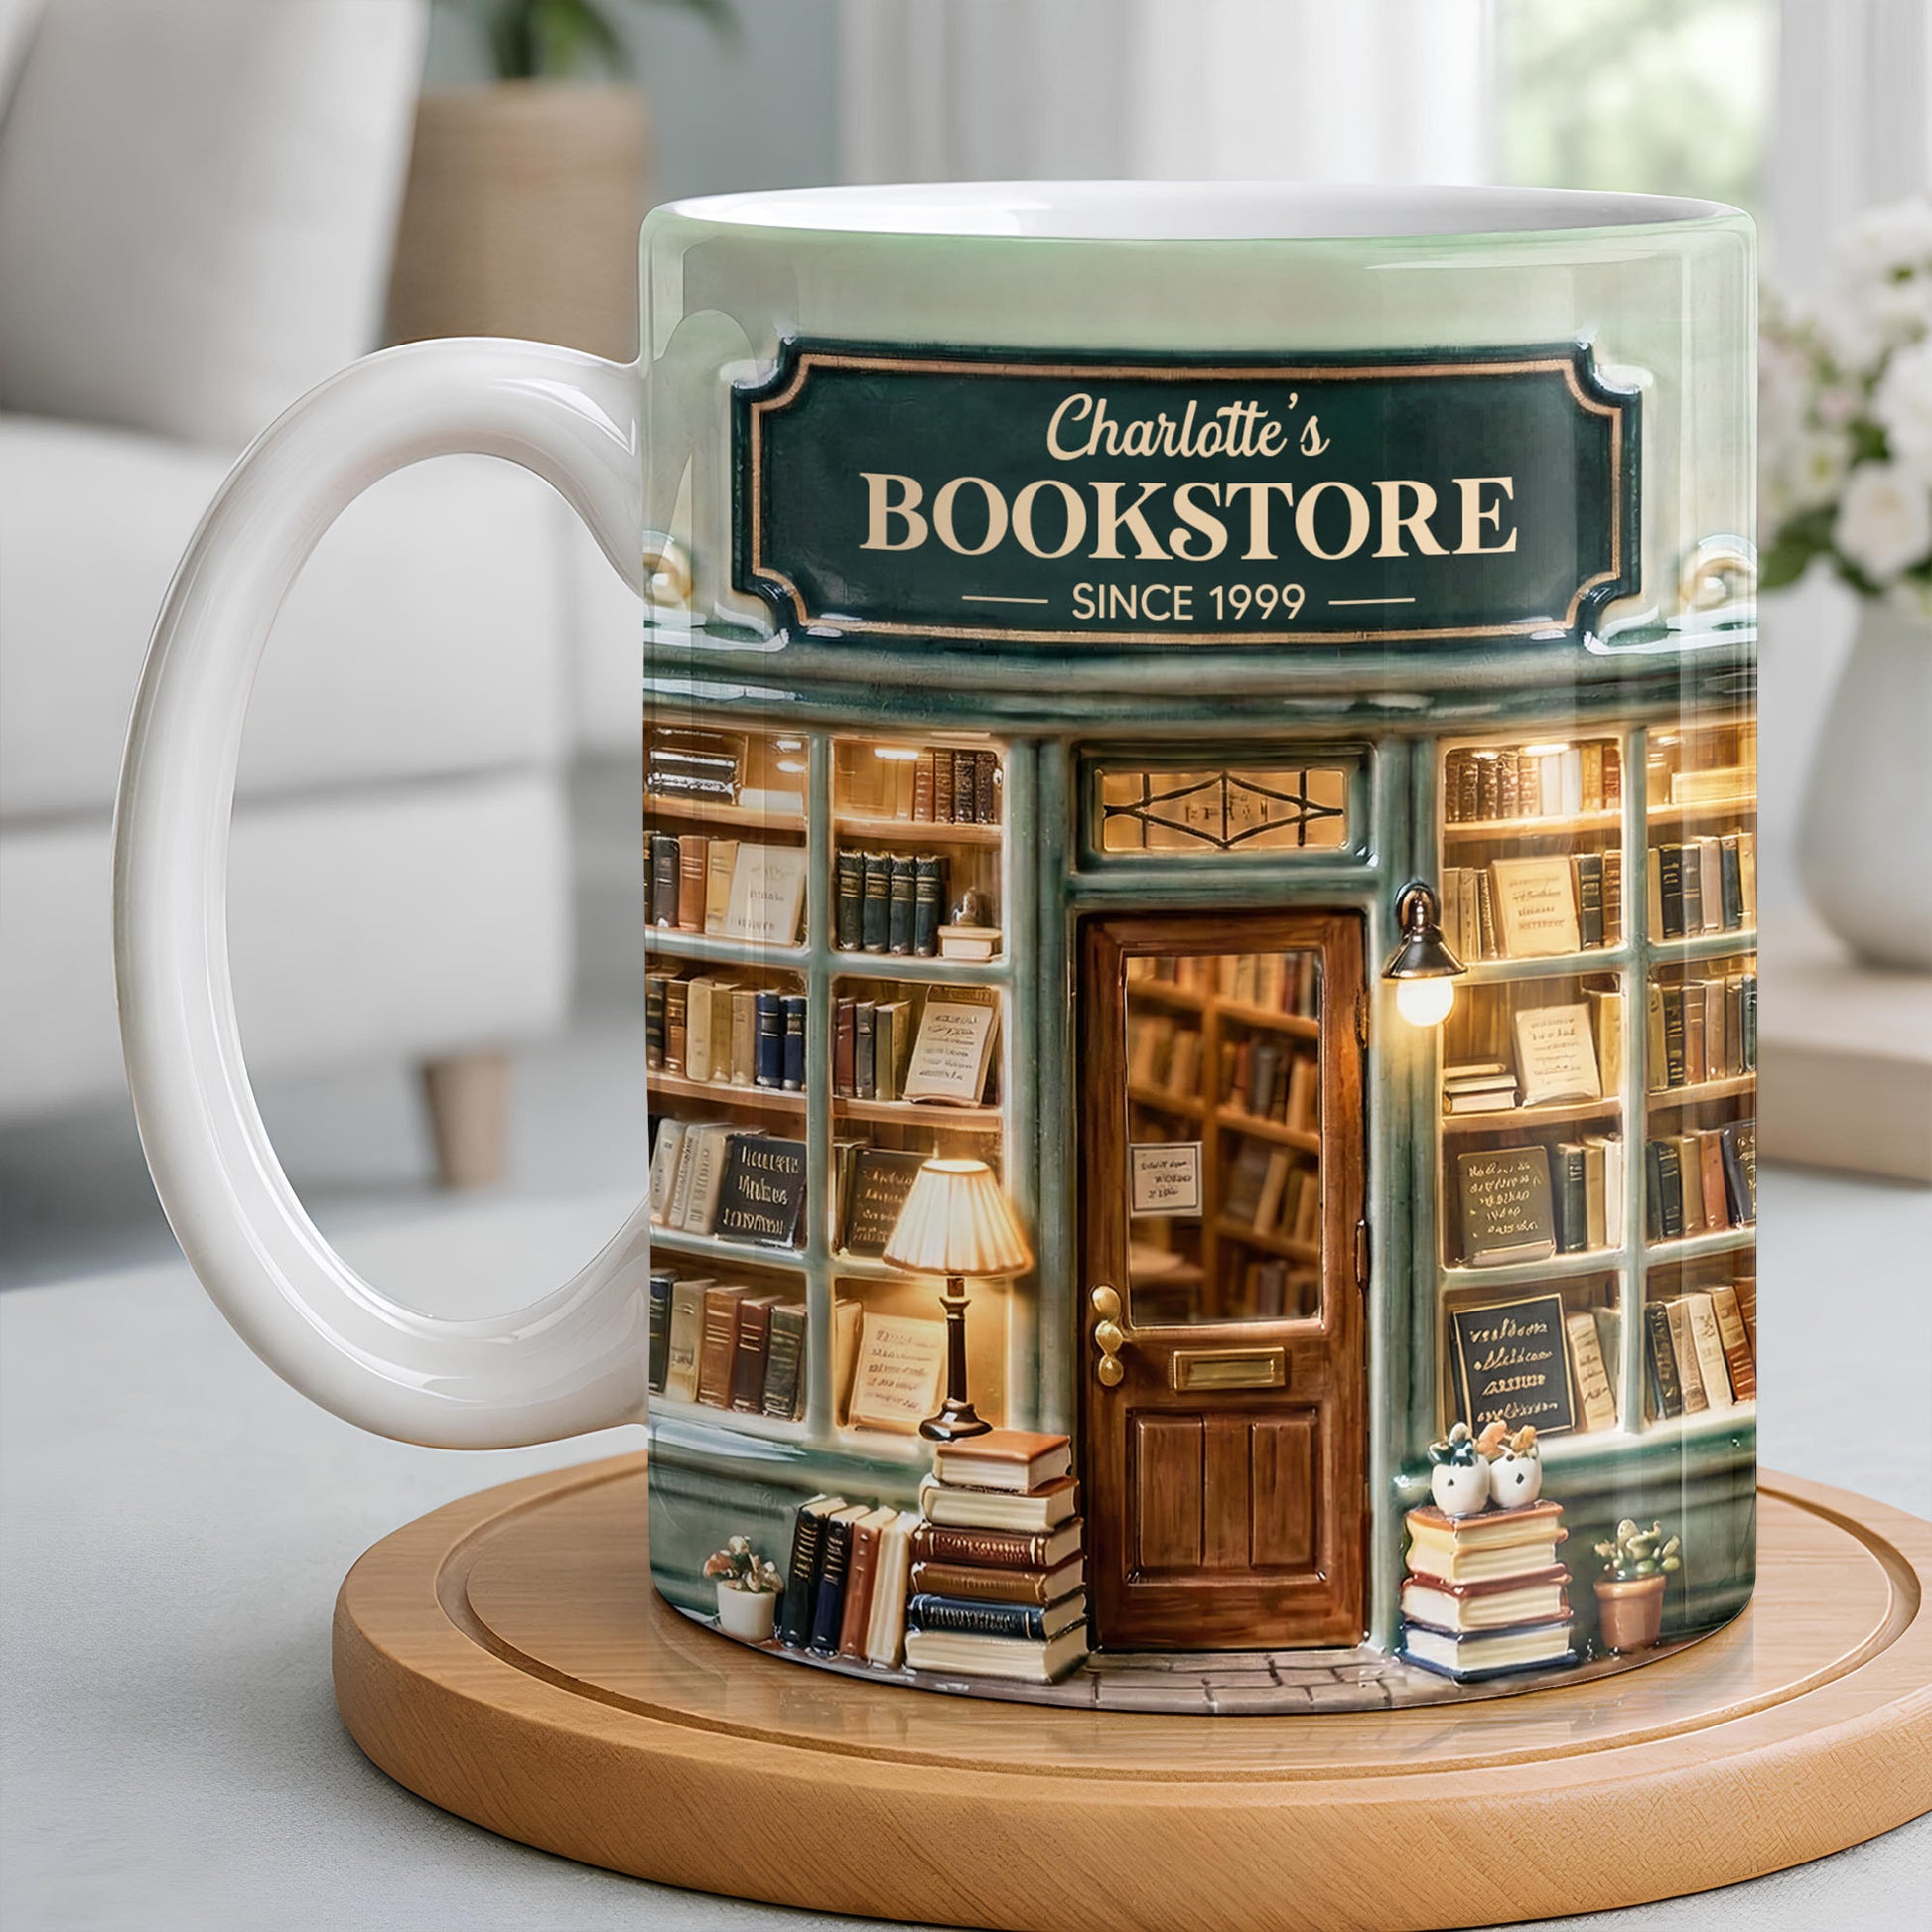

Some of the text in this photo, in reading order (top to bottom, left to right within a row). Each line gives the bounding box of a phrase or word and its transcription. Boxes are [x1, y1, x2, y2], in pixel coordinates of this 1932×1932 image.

[860, 473, 1517, 561] BOOKSTORE
[1073, 583, 1305, 620] SINCE 1999
